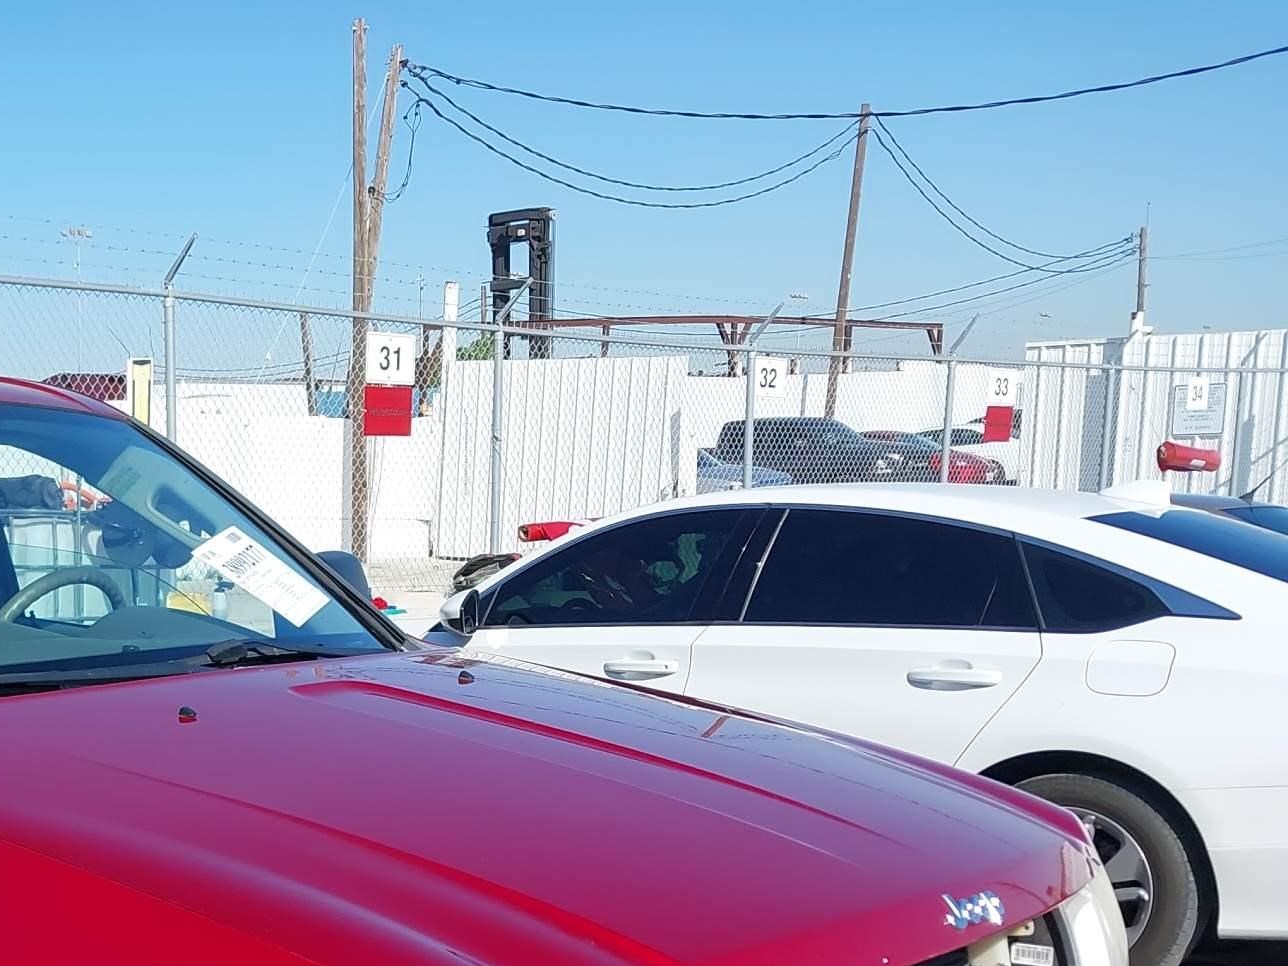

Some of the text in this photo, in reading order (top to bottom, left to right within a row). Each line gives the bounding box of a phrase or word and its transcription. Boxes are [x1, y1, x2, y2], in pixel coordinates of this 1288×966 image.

[379, 346, 401, 371] 31
[759, 367, 777, 388] 32
[994, 377, 1009, 396] 33
[1191, 384, 1203, 402] 34
